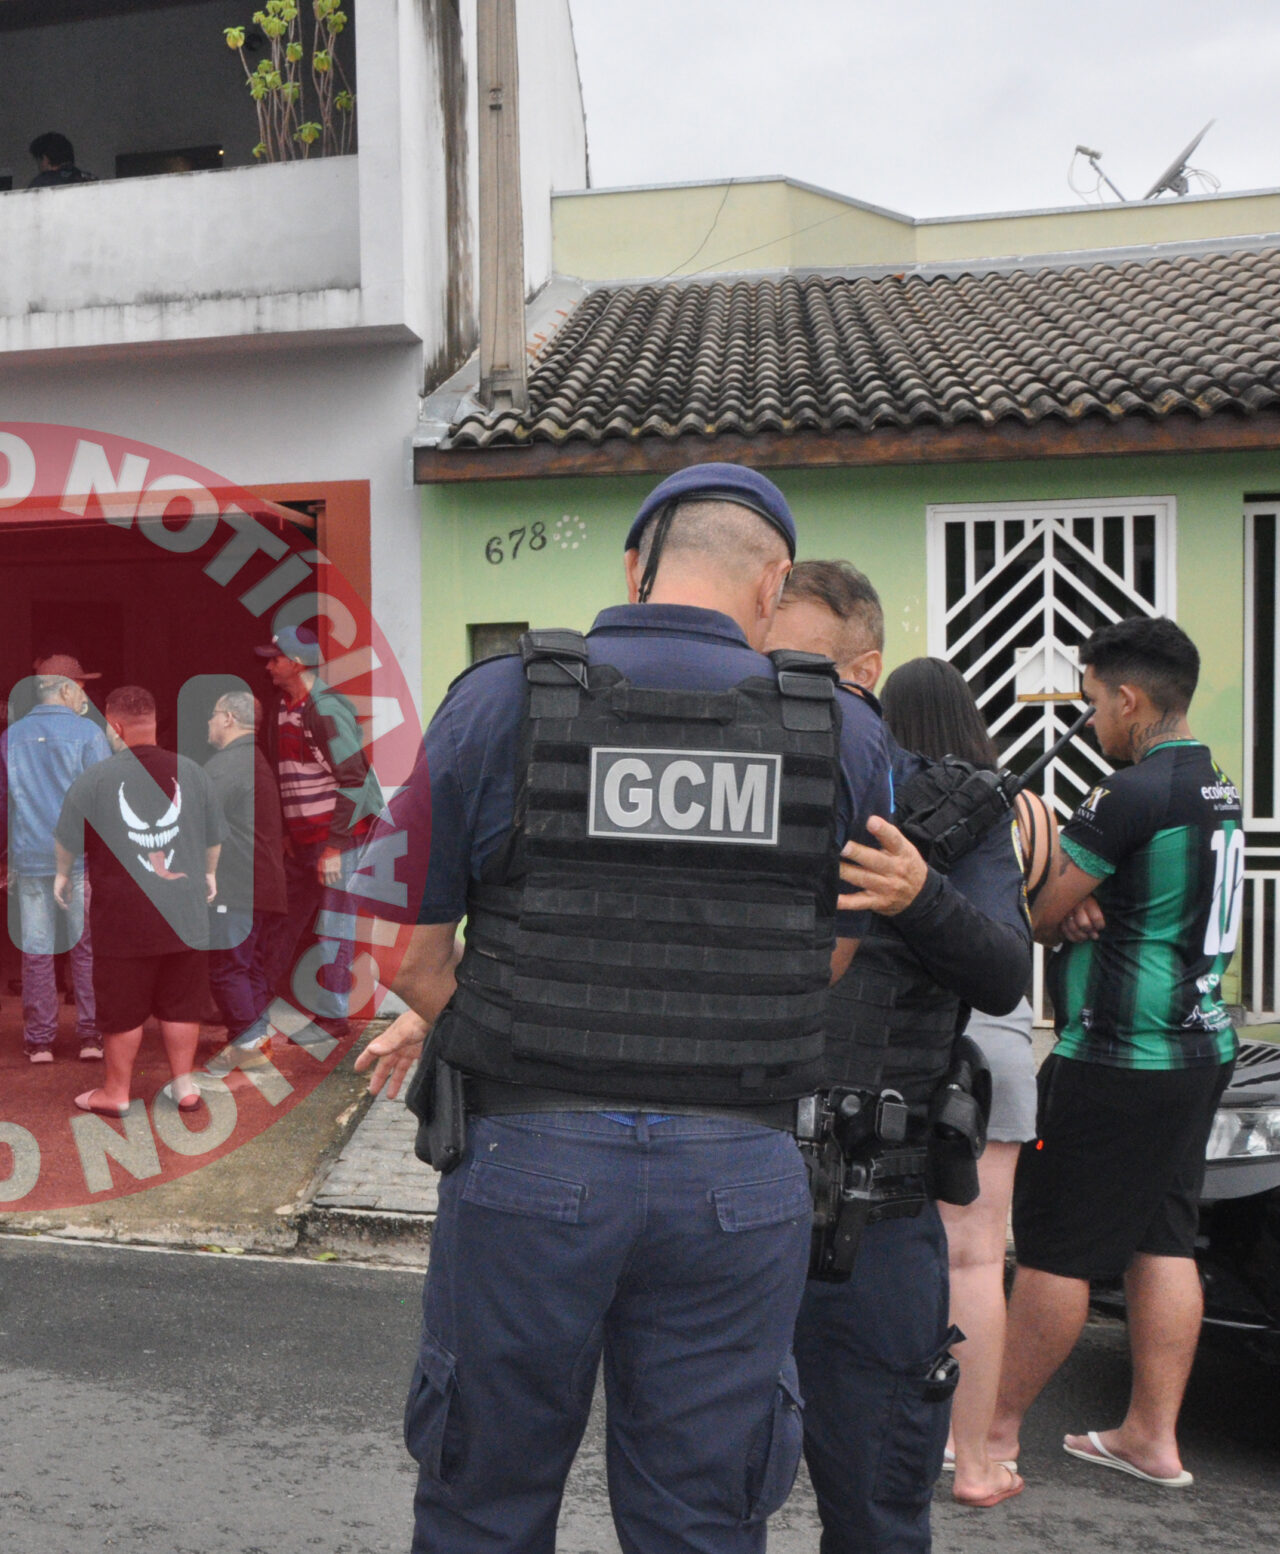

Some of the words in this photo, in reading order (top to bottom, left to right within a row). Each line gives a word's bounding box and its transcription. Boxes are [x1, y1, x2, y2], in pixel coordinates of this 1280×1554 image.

[485, 521, 548, 565] 678
[603, 758, 768, 833] GCM
[1204, 829, 1245, 955] 10
